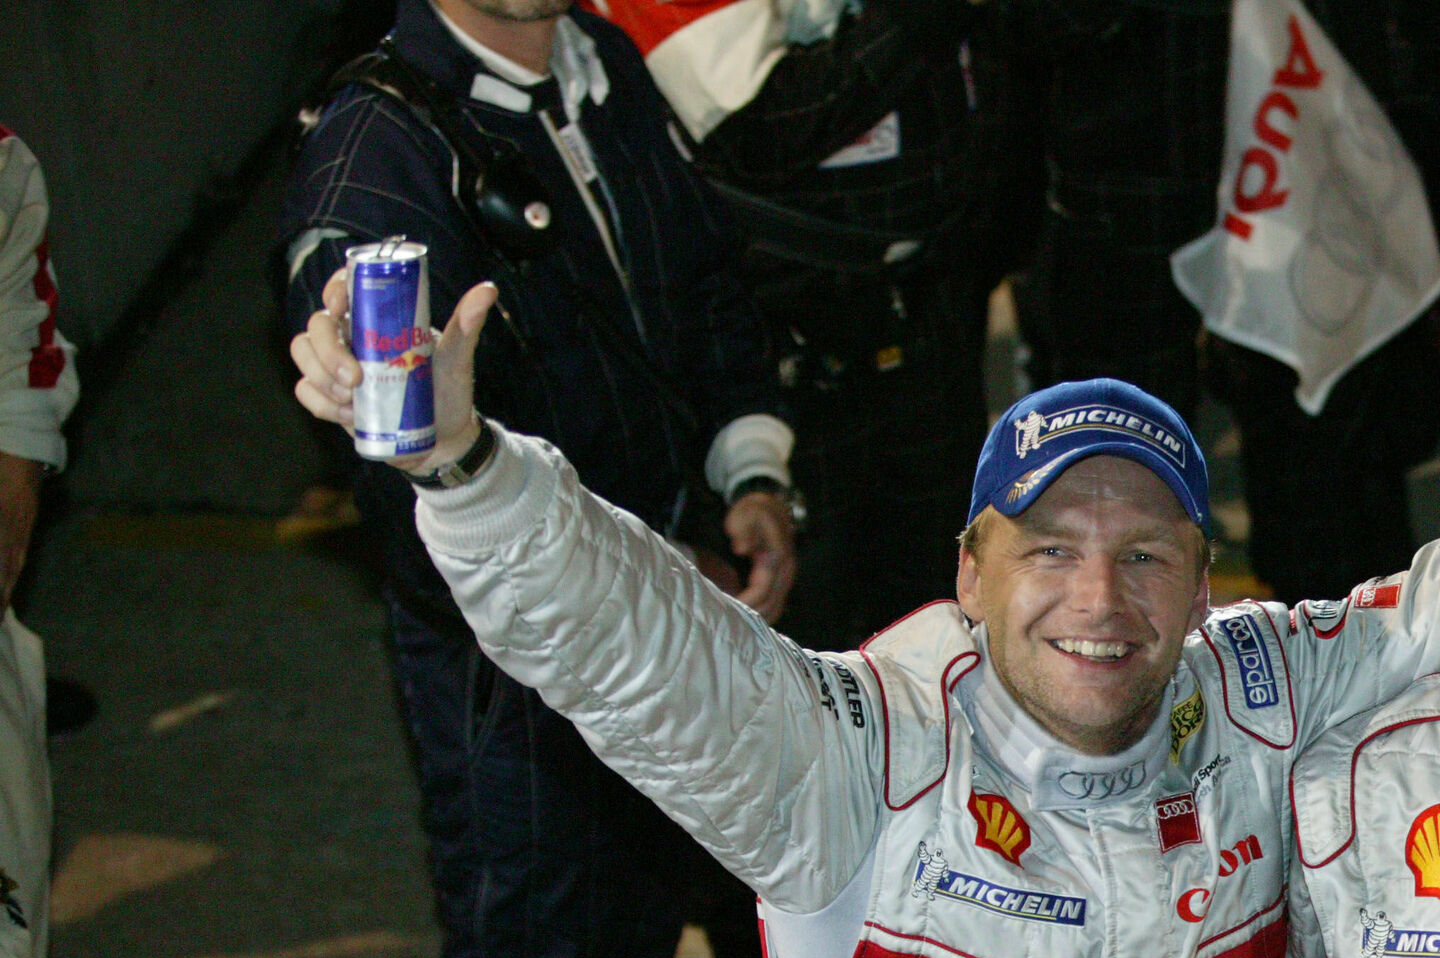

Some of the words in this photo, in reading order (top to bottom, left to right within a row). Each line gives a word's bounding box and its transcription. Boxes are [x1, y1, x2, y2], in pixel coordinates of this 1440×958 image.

[1222, 13, 1325, 243] Audi
[363, 327, 408, 351] Red
[1048, 409, 1182, 453] MICHELIN
[949, 875, 1084, 920] MICHELIN
